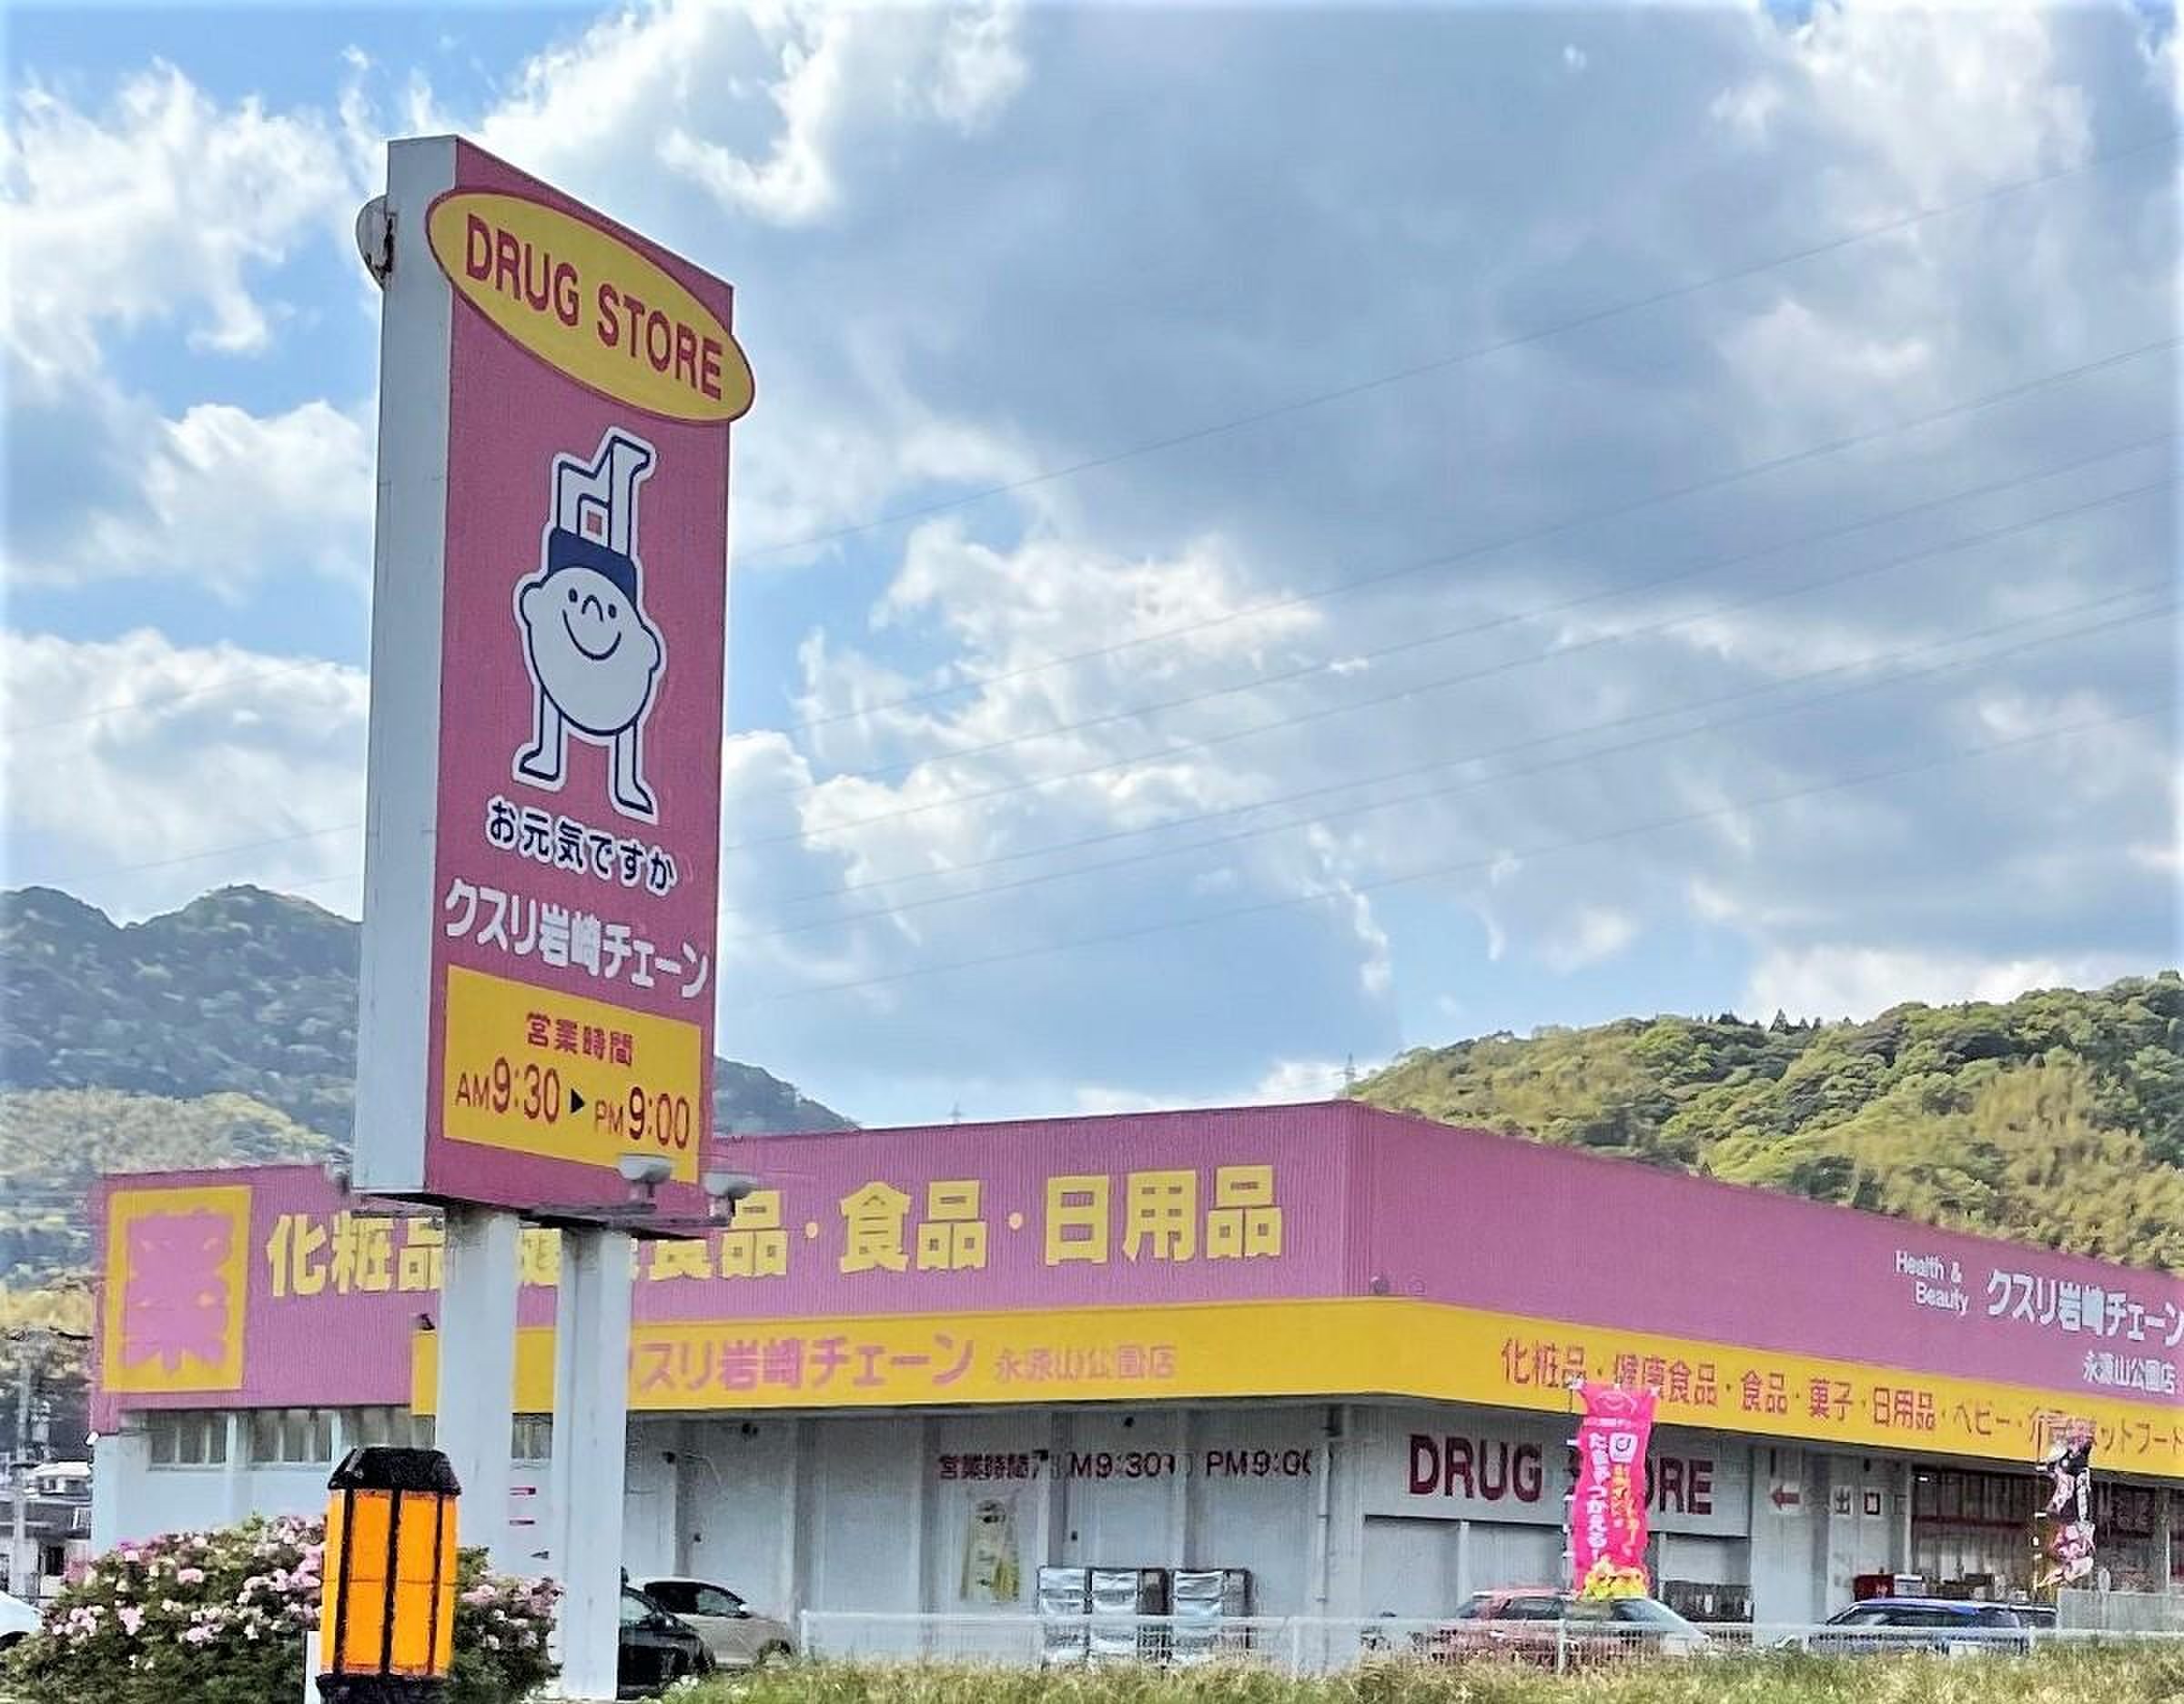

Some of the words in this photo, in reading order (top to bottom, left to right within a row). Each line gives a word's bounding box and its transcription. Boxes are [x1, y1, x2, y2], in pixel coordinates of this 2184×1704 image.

[466, 212, 580, 327] DRUG
[597, 283, 723, 400] STORE
[487, 796, 676, 894] お元気ですか
[445, 878, 708, 999] クスリ岩崎チェーン
[526, 1012, 633, 1067] 営業時間
[456, 1057, 560, 1123] AM9:30
[595, 1086, 690, 1151] PM9:00
[1896, 1251, 1945, 1281] Health
[1951, 1262, 1963, 1284] &
[1915, 1282, 1969, 1315] Beauty
[630, 1333, 976, 1392] スリ岩崎チェーン
[1409, 1433, 1543, 1503] DRUG
